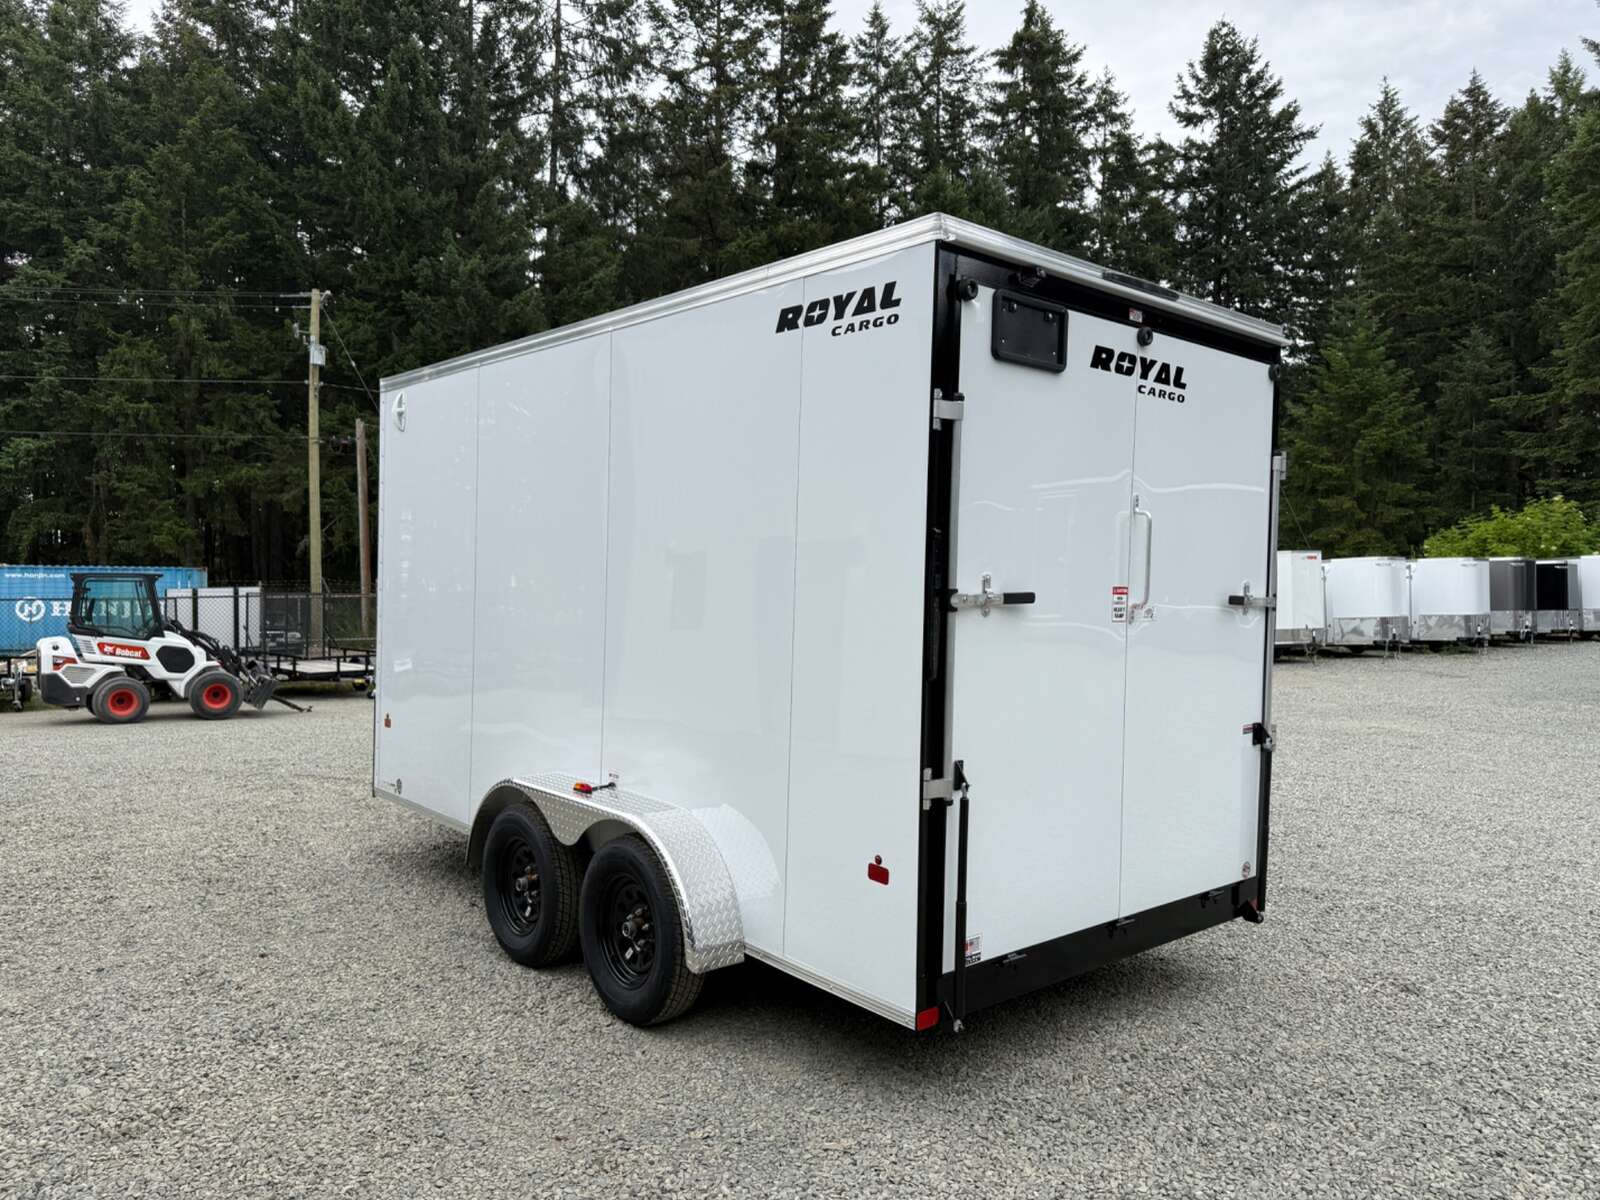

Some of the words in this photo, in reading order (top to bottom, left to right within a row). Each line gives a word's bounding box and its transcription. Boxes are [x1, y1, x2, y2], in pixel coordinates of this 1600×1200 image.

[775, 281, 902, 334] ROYAL
[831, 313, 900, 337] CARGO
[1090, 345, 1187, 391] ROYAL
[1137, 384, 1186, 404] CARGO
[115, 647, 142, 657] Bobcat
